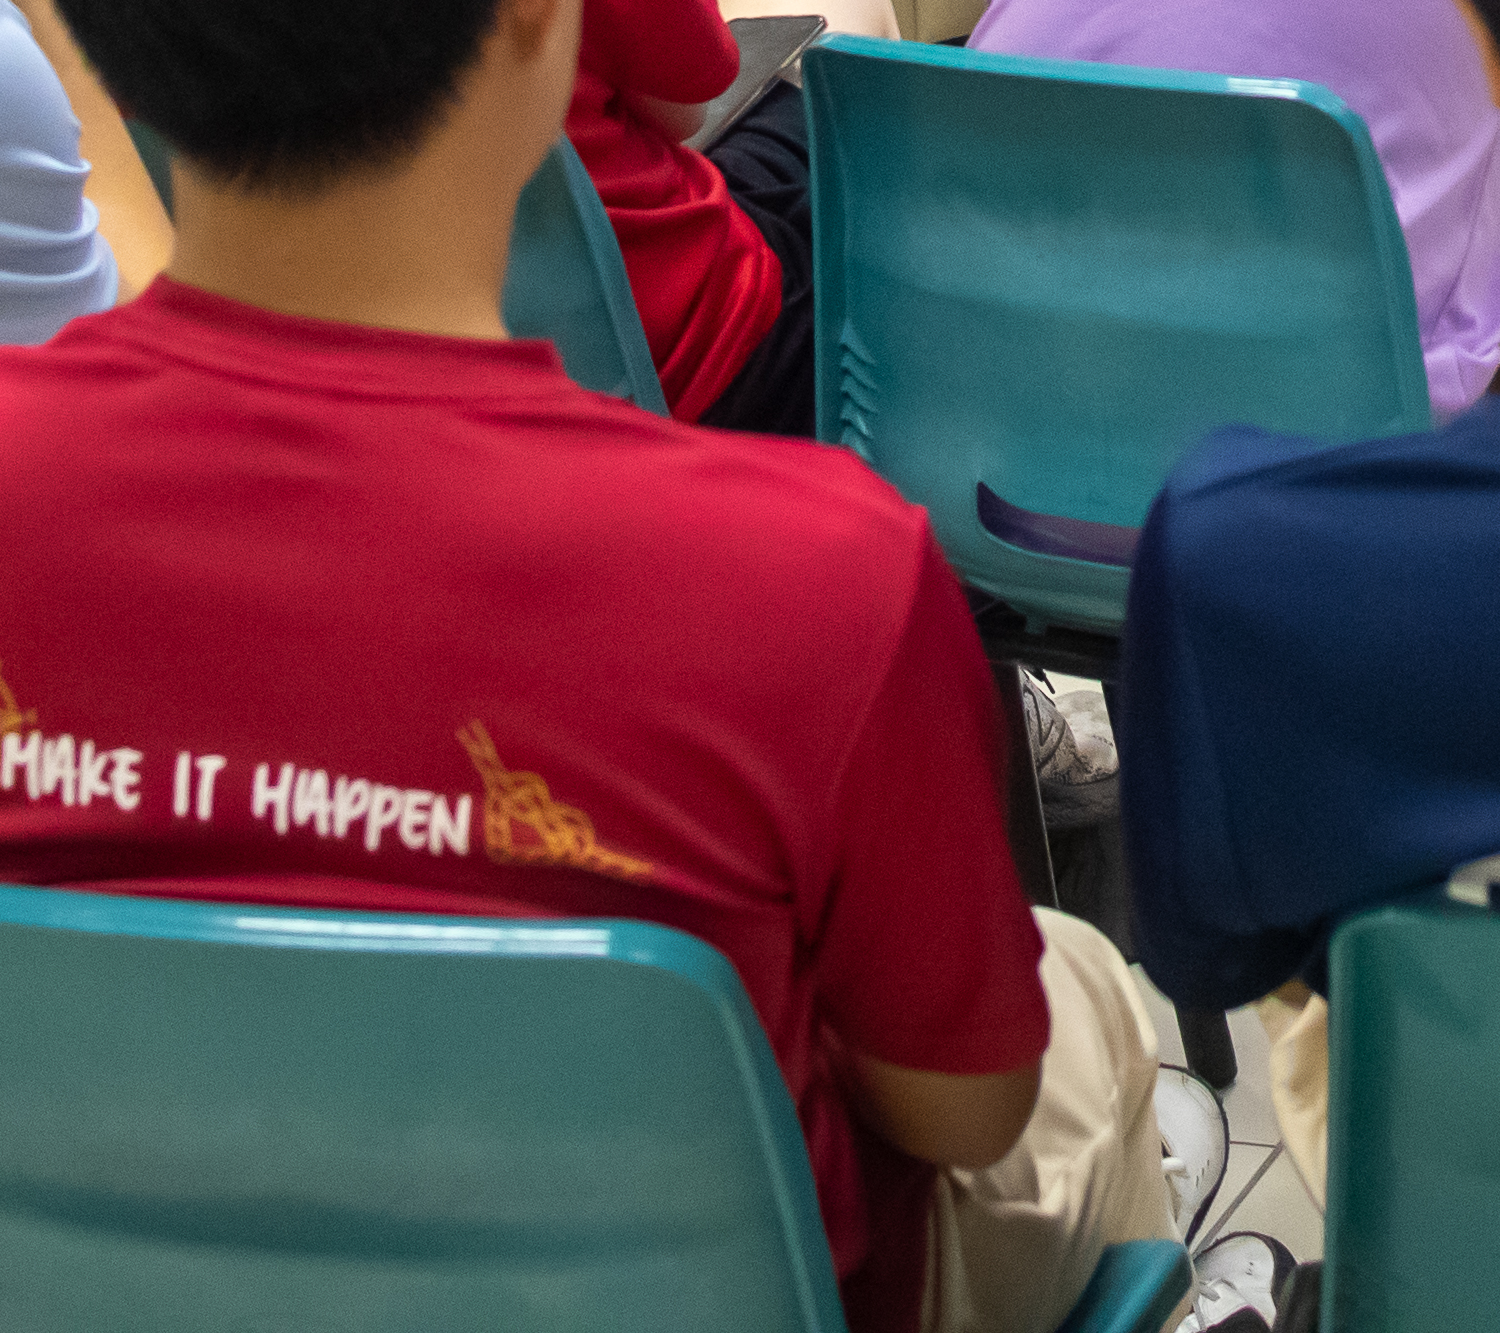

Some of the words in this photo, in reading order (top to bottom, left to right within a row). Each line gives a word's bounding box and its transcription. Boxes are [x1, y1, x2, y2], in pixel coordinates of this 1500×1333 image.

[0, 729, 144, 810] MAKE
[172, 750, 228, 822] IT
[251, 761, 474, 857] HAPPEN
